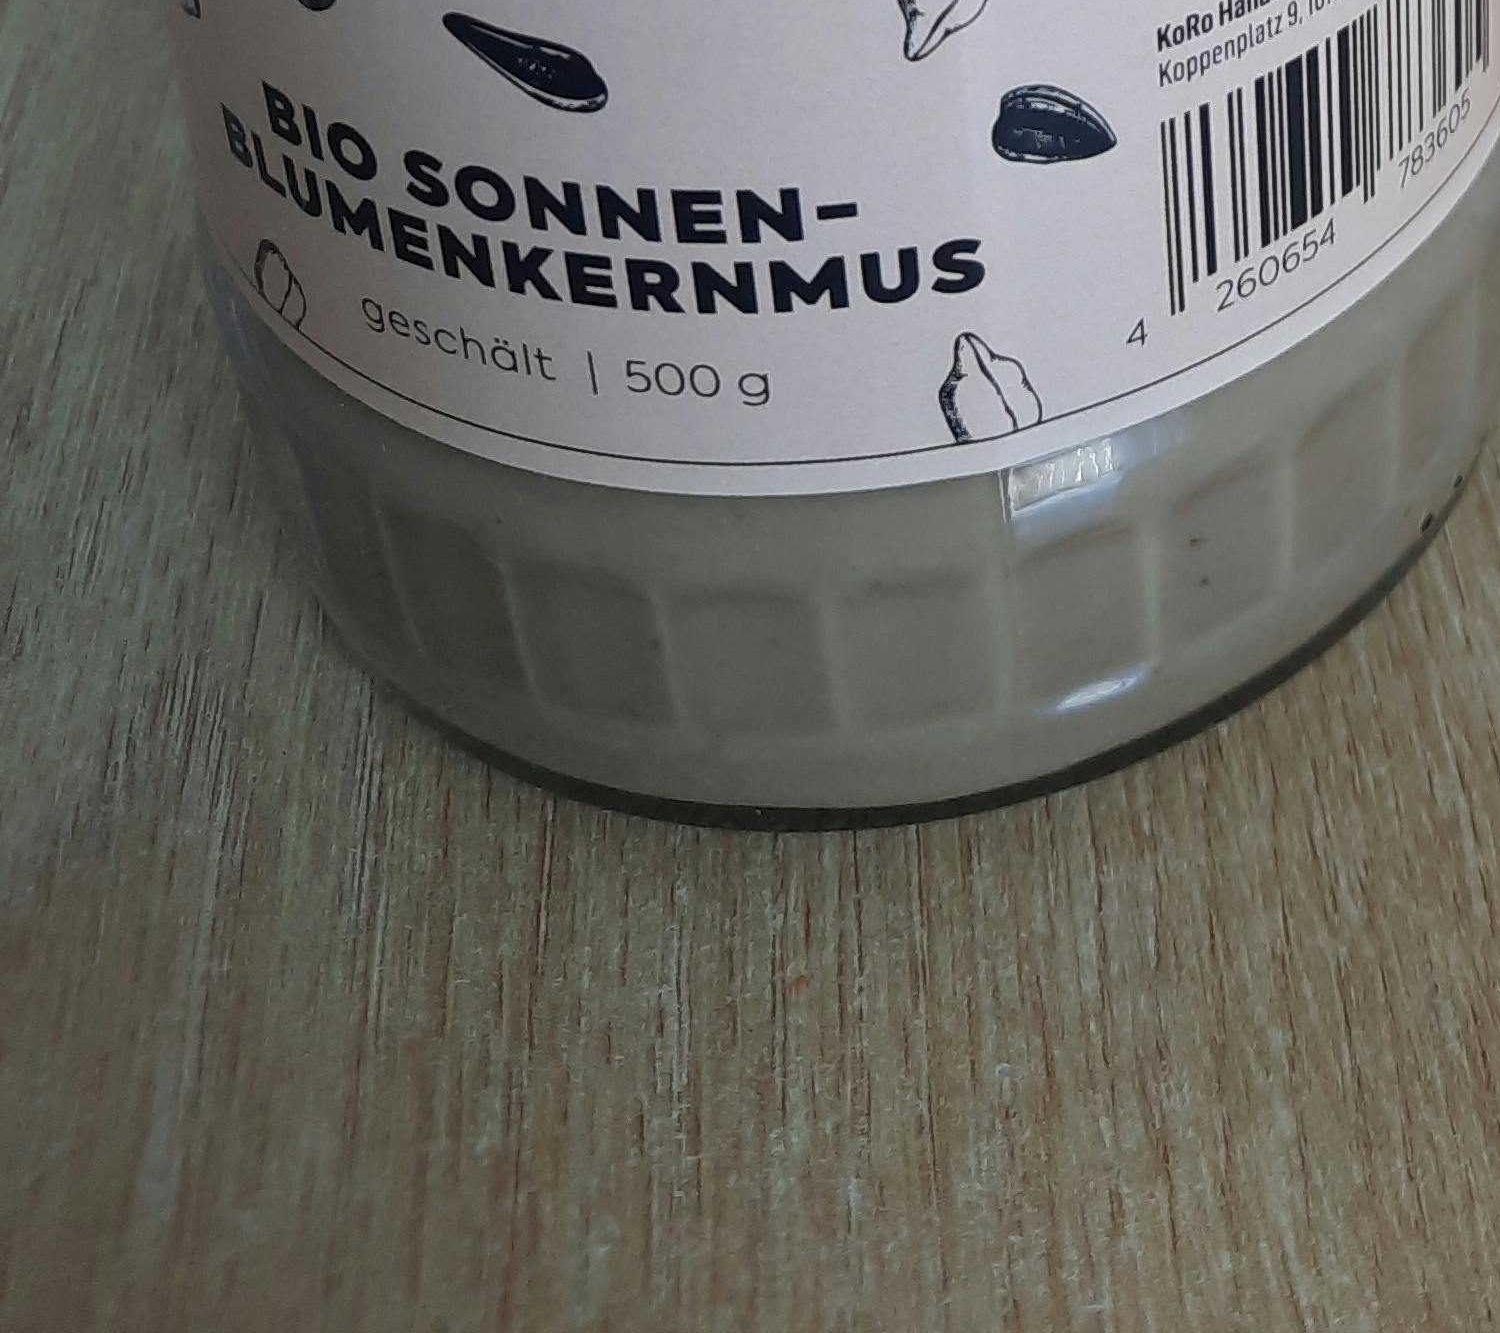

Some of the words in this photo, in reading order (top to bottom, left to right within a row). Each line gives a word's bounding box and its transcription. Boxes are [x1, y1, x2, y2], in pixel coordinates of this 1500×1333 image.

[1156, 15, 1214, 52] KoRo
[1158, 11, 1284, 87] Koppenplatz
[1287, 0, 1304, 29] 9,
[220, 102, 986, 314] BLUMENKERNMUS
[261, 78, 379, 181] BIO
[404, 149, 858, 245] SONNEN-
[1126, 318, 1149, 345] 4
[1216, 218, 1337, 312] 260654
[1398, 89, 1472, 189] 783605
[361, 294, 557, 383] geschält
[625, 360, 721, 399] 500
[737, 370, 772, 406] g
